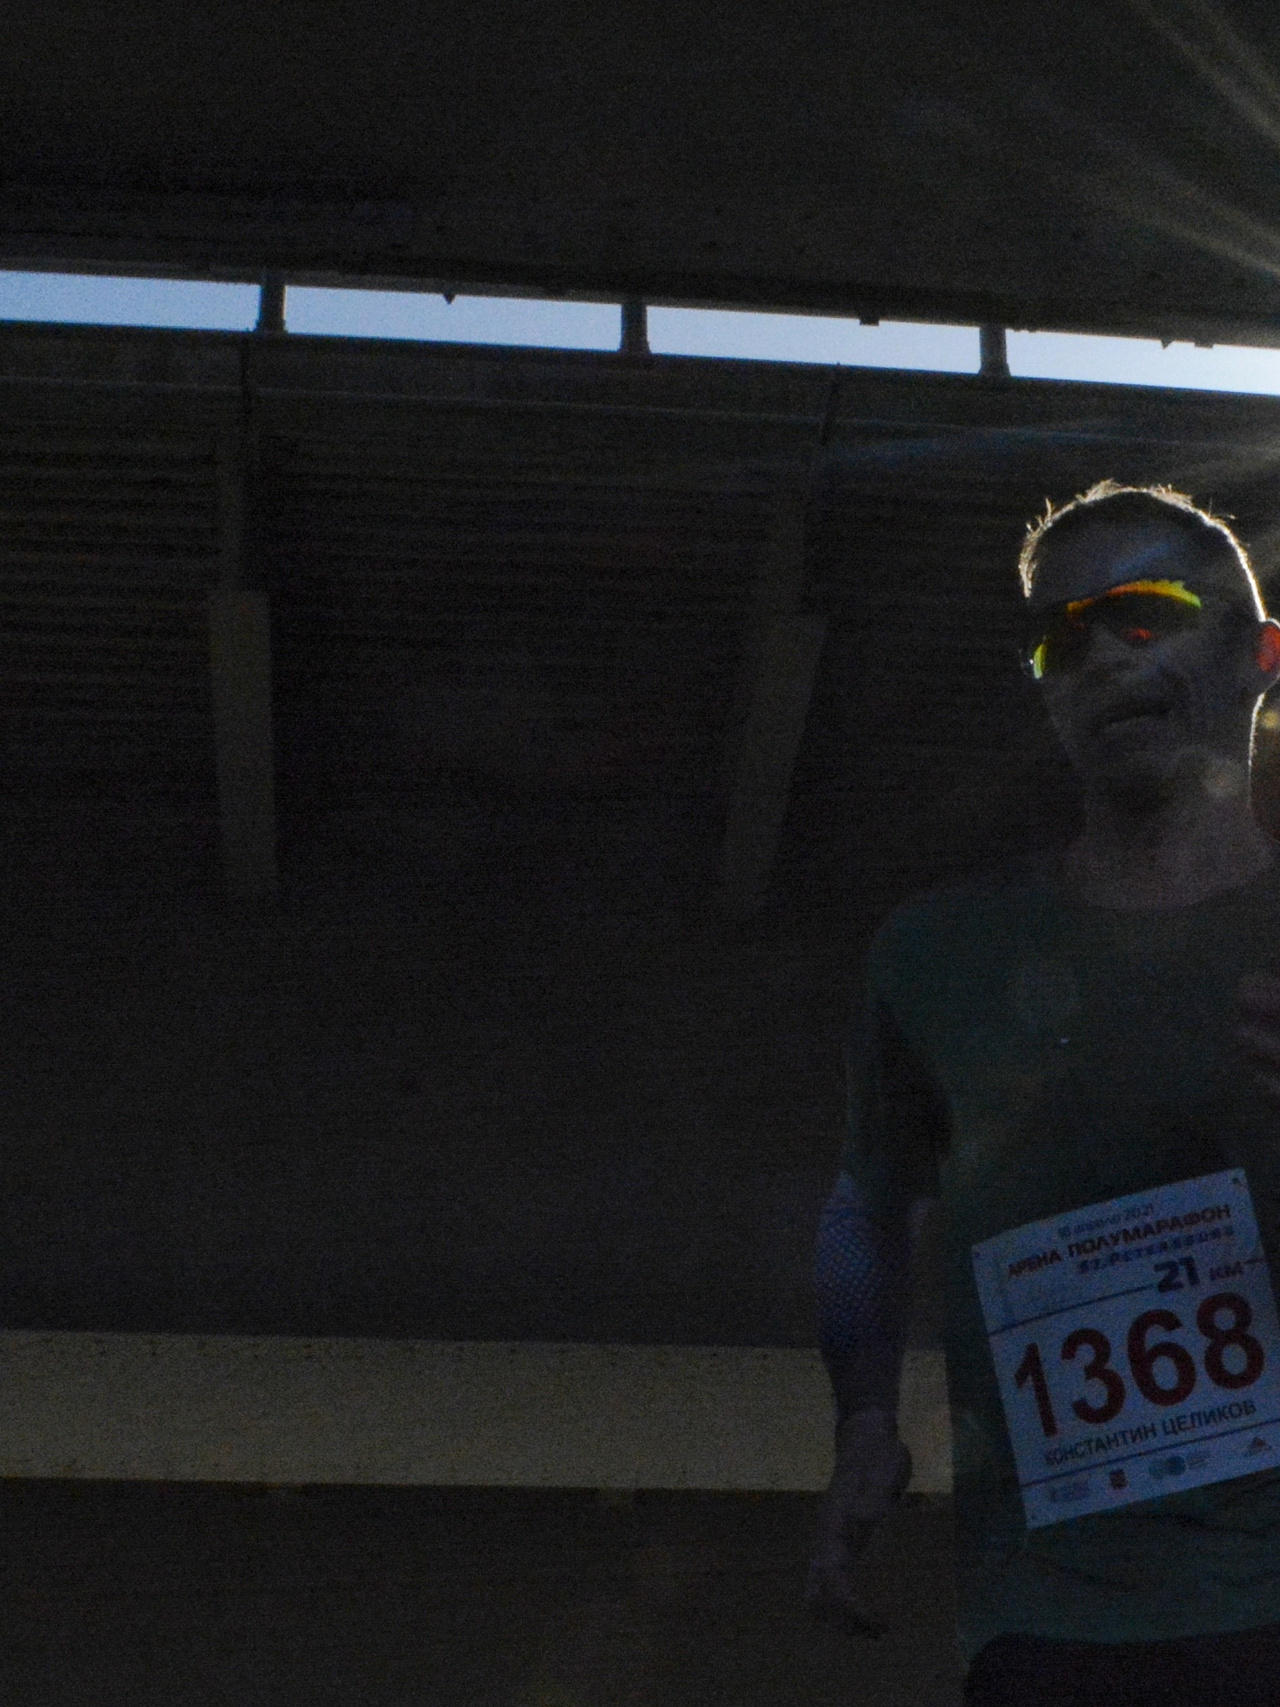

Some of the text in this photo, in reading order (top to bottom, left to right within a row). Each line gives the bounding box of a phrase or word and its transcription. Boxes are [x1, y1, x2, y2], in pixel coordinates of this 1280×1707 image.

[1008, 1204, 1230, 1279] АРЕНА ПОЛУМАРАФОН
[1154, 1256, 1199, 1293] 21
[1014, 1292, 1264, 1437] 1368
[1045, 1424, 1158, 1466] КОНСТАНТИН
[1162, 1400, 1257, 1436] ЦЕЛИКОВ
